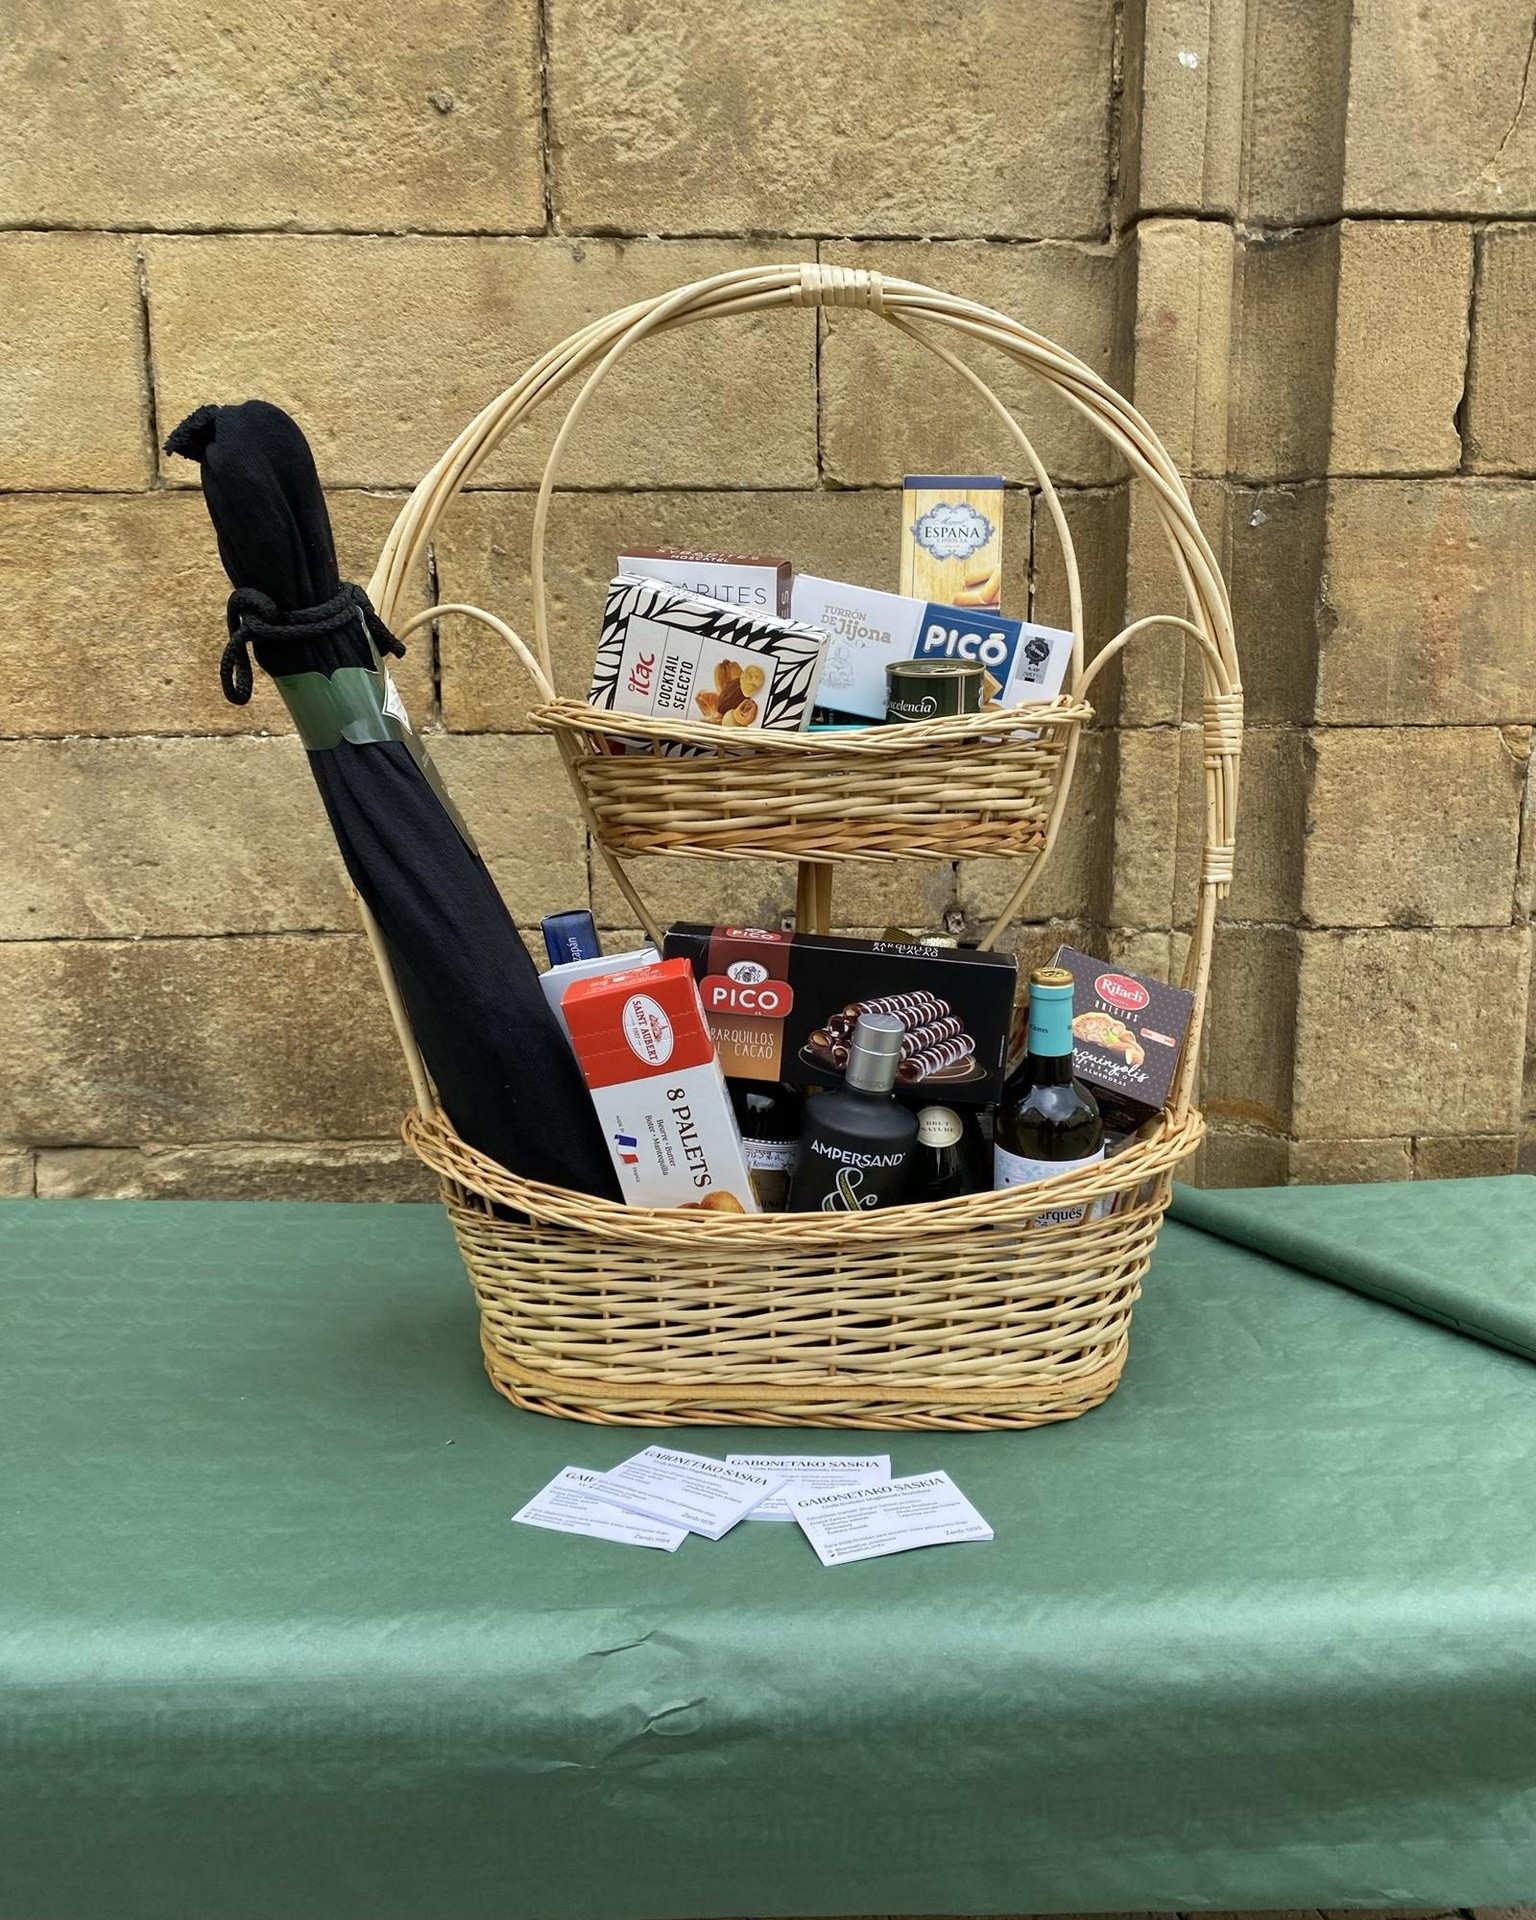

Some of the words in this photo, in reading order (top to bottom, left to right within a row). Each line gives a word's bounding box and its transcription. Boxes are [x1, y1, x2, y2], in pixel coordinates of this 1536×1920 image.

[925, 524, 980, 538] ESPAÑA
[670, 554, 730, 563] MOSCATEL
[824, 604, 867, 621] TURRÓN
[820, 615, 837, 626] DE
[834, 618, 891, 644] Jijona
[657, 655, 679, 707] COCKTAIL
[673, 661, 694, 710] SELECTO
[732, 929, 774, 940] PICO
[873, 941, 939, 952] BARQUILLOS
[568, 936, 583, 962] zapán
[898, 949, 939, 957] CACAO
[712, 987, 779, 1010] PICO
[632, 1000, 647, 1026] SAINT
[641, 1028, 658, 1060] AUBERT
[710, 1027, 774, 1046] BARQUILLOS
[734, 1043, 773, 1060] CACAO
[1072, 1047, 1149, 1083] rquinyolis
[666, 1088, 685, 1101] 8
[645, 1115, 655, 1133] Boter
[653, 1137, 668, 1176] Mantequilla
[656, 1119, 668, 1141] Beurre
[665, 1146, 676, 1167] Butter
[671, 1105, 712, 1188] PALETS
[810, 1139, 904, 1168] AMPERSAND
[645, 1451, 723, 1473] GABONETAKO
[725, 1469, 767, 1486] SASKIA
[731, 1460, 825, 1468] GABONETAKO
[828, 1460, 879, 1468] SASKIA
[798, 1485, 892, 1508] GABONETAKO
[893, 1477, 945, 1491] SASKIA
